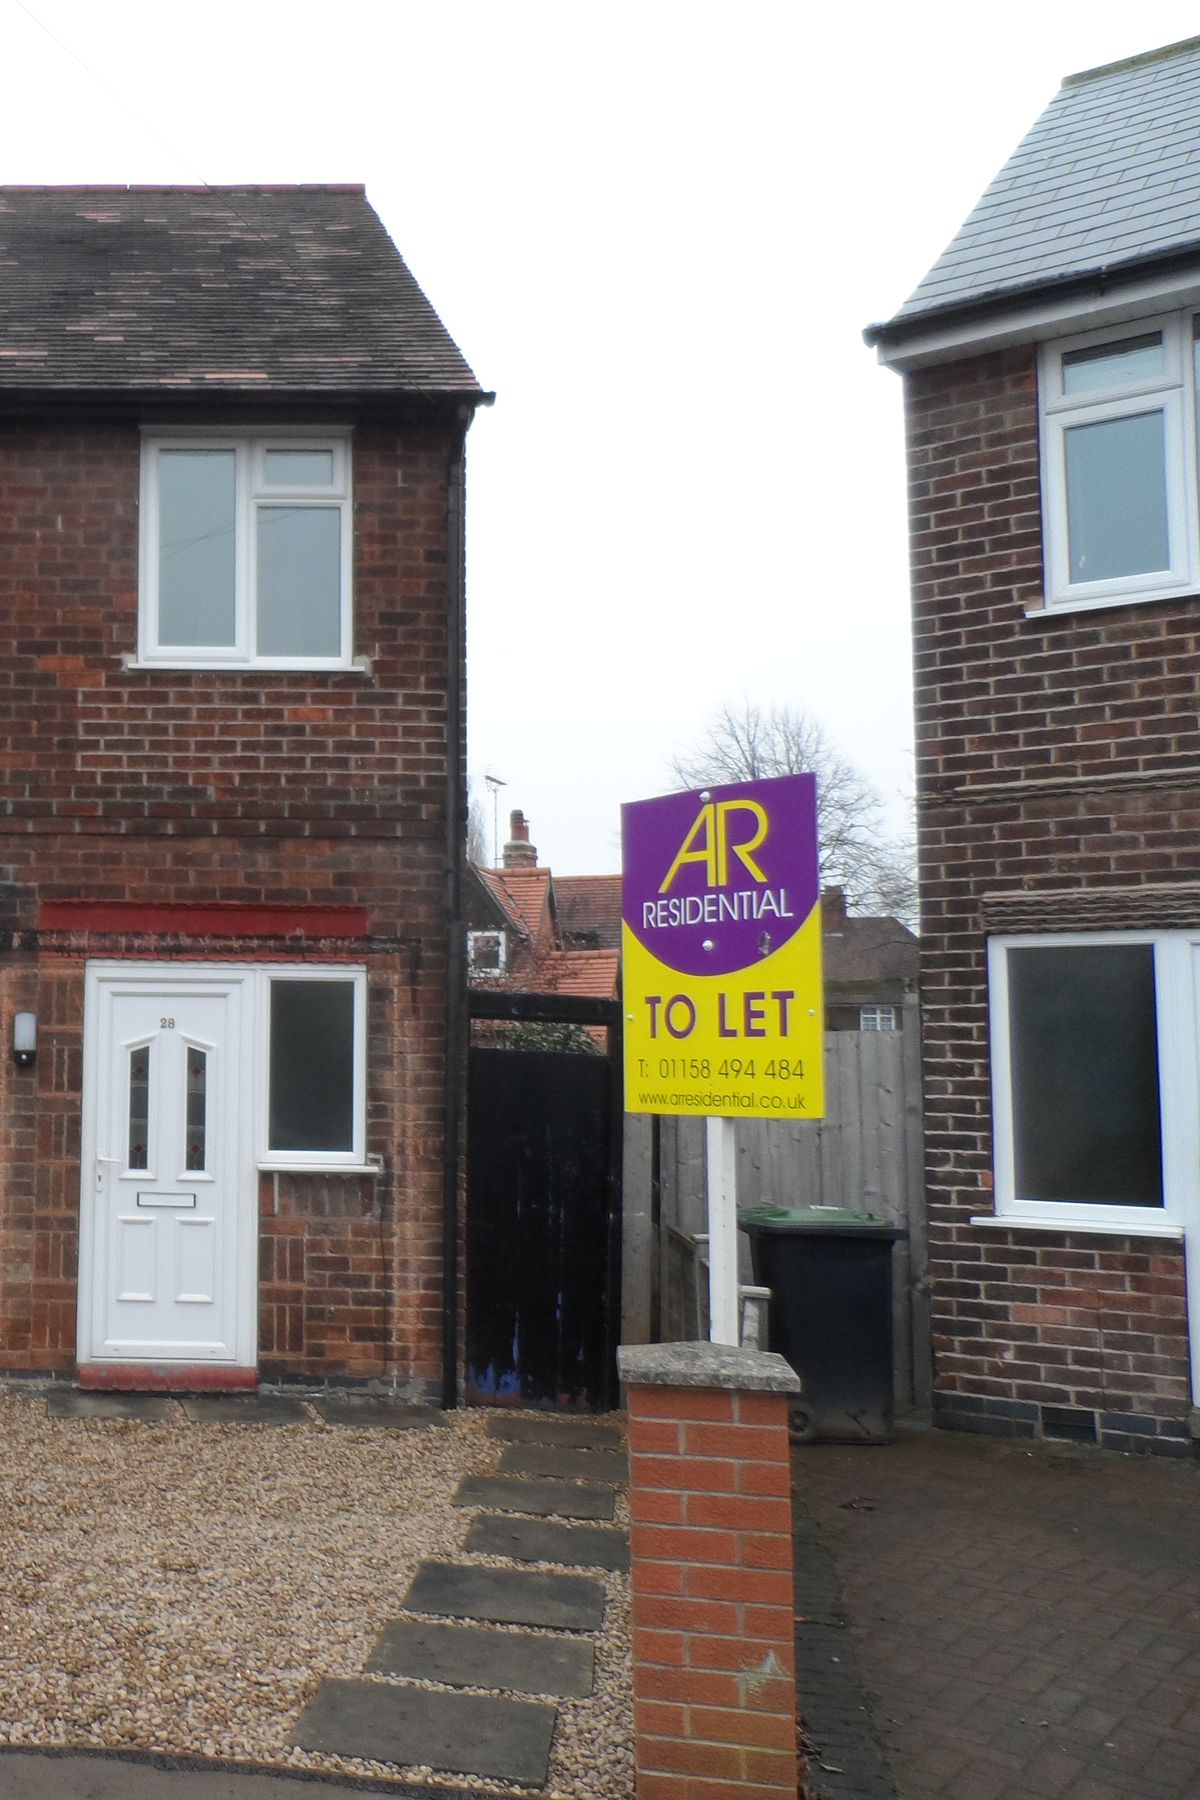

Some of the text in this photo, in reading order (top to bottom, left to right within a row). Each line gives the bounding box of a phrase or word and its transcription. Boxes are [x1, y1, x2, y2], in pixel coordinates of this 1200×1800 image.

[658, 799, 769, 894] AR
[642, 888, 794, 929] RESIDENTIAL
[160, 1017, 175, 1029] 28
[645, 990, 795, 1039] TO LET
[638, 1058, 805, 1080] T: 01158 494 484
[638, 1091, 806, 1110] www.arresidential.co.uk
